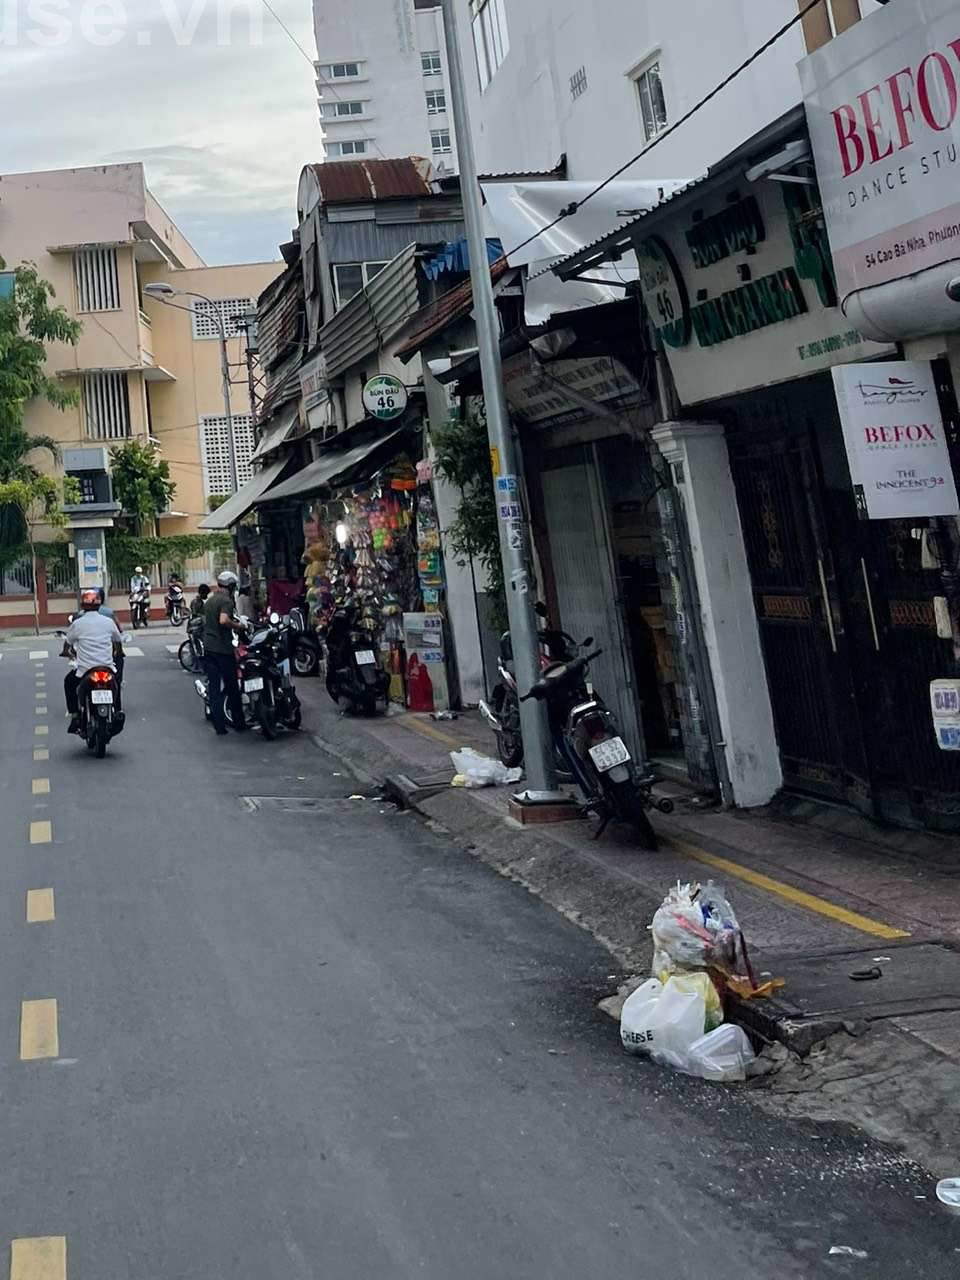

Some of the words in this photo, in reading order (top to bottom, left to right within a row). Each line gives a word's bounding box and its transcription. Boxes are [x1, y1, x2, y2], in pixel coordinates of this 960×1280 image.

[830, 38, 960, 178] BEFO
[848, 166, 907, 208] DANCE
[865, 253, 876, 268] 54
[877, 249, 893, 263] Cao
[656, 290, 675, 323] 46
[378, 396, 394, 408] 46
[865, 424, 936, 443] BEFOX
[897, 470, 917, 478] THE
